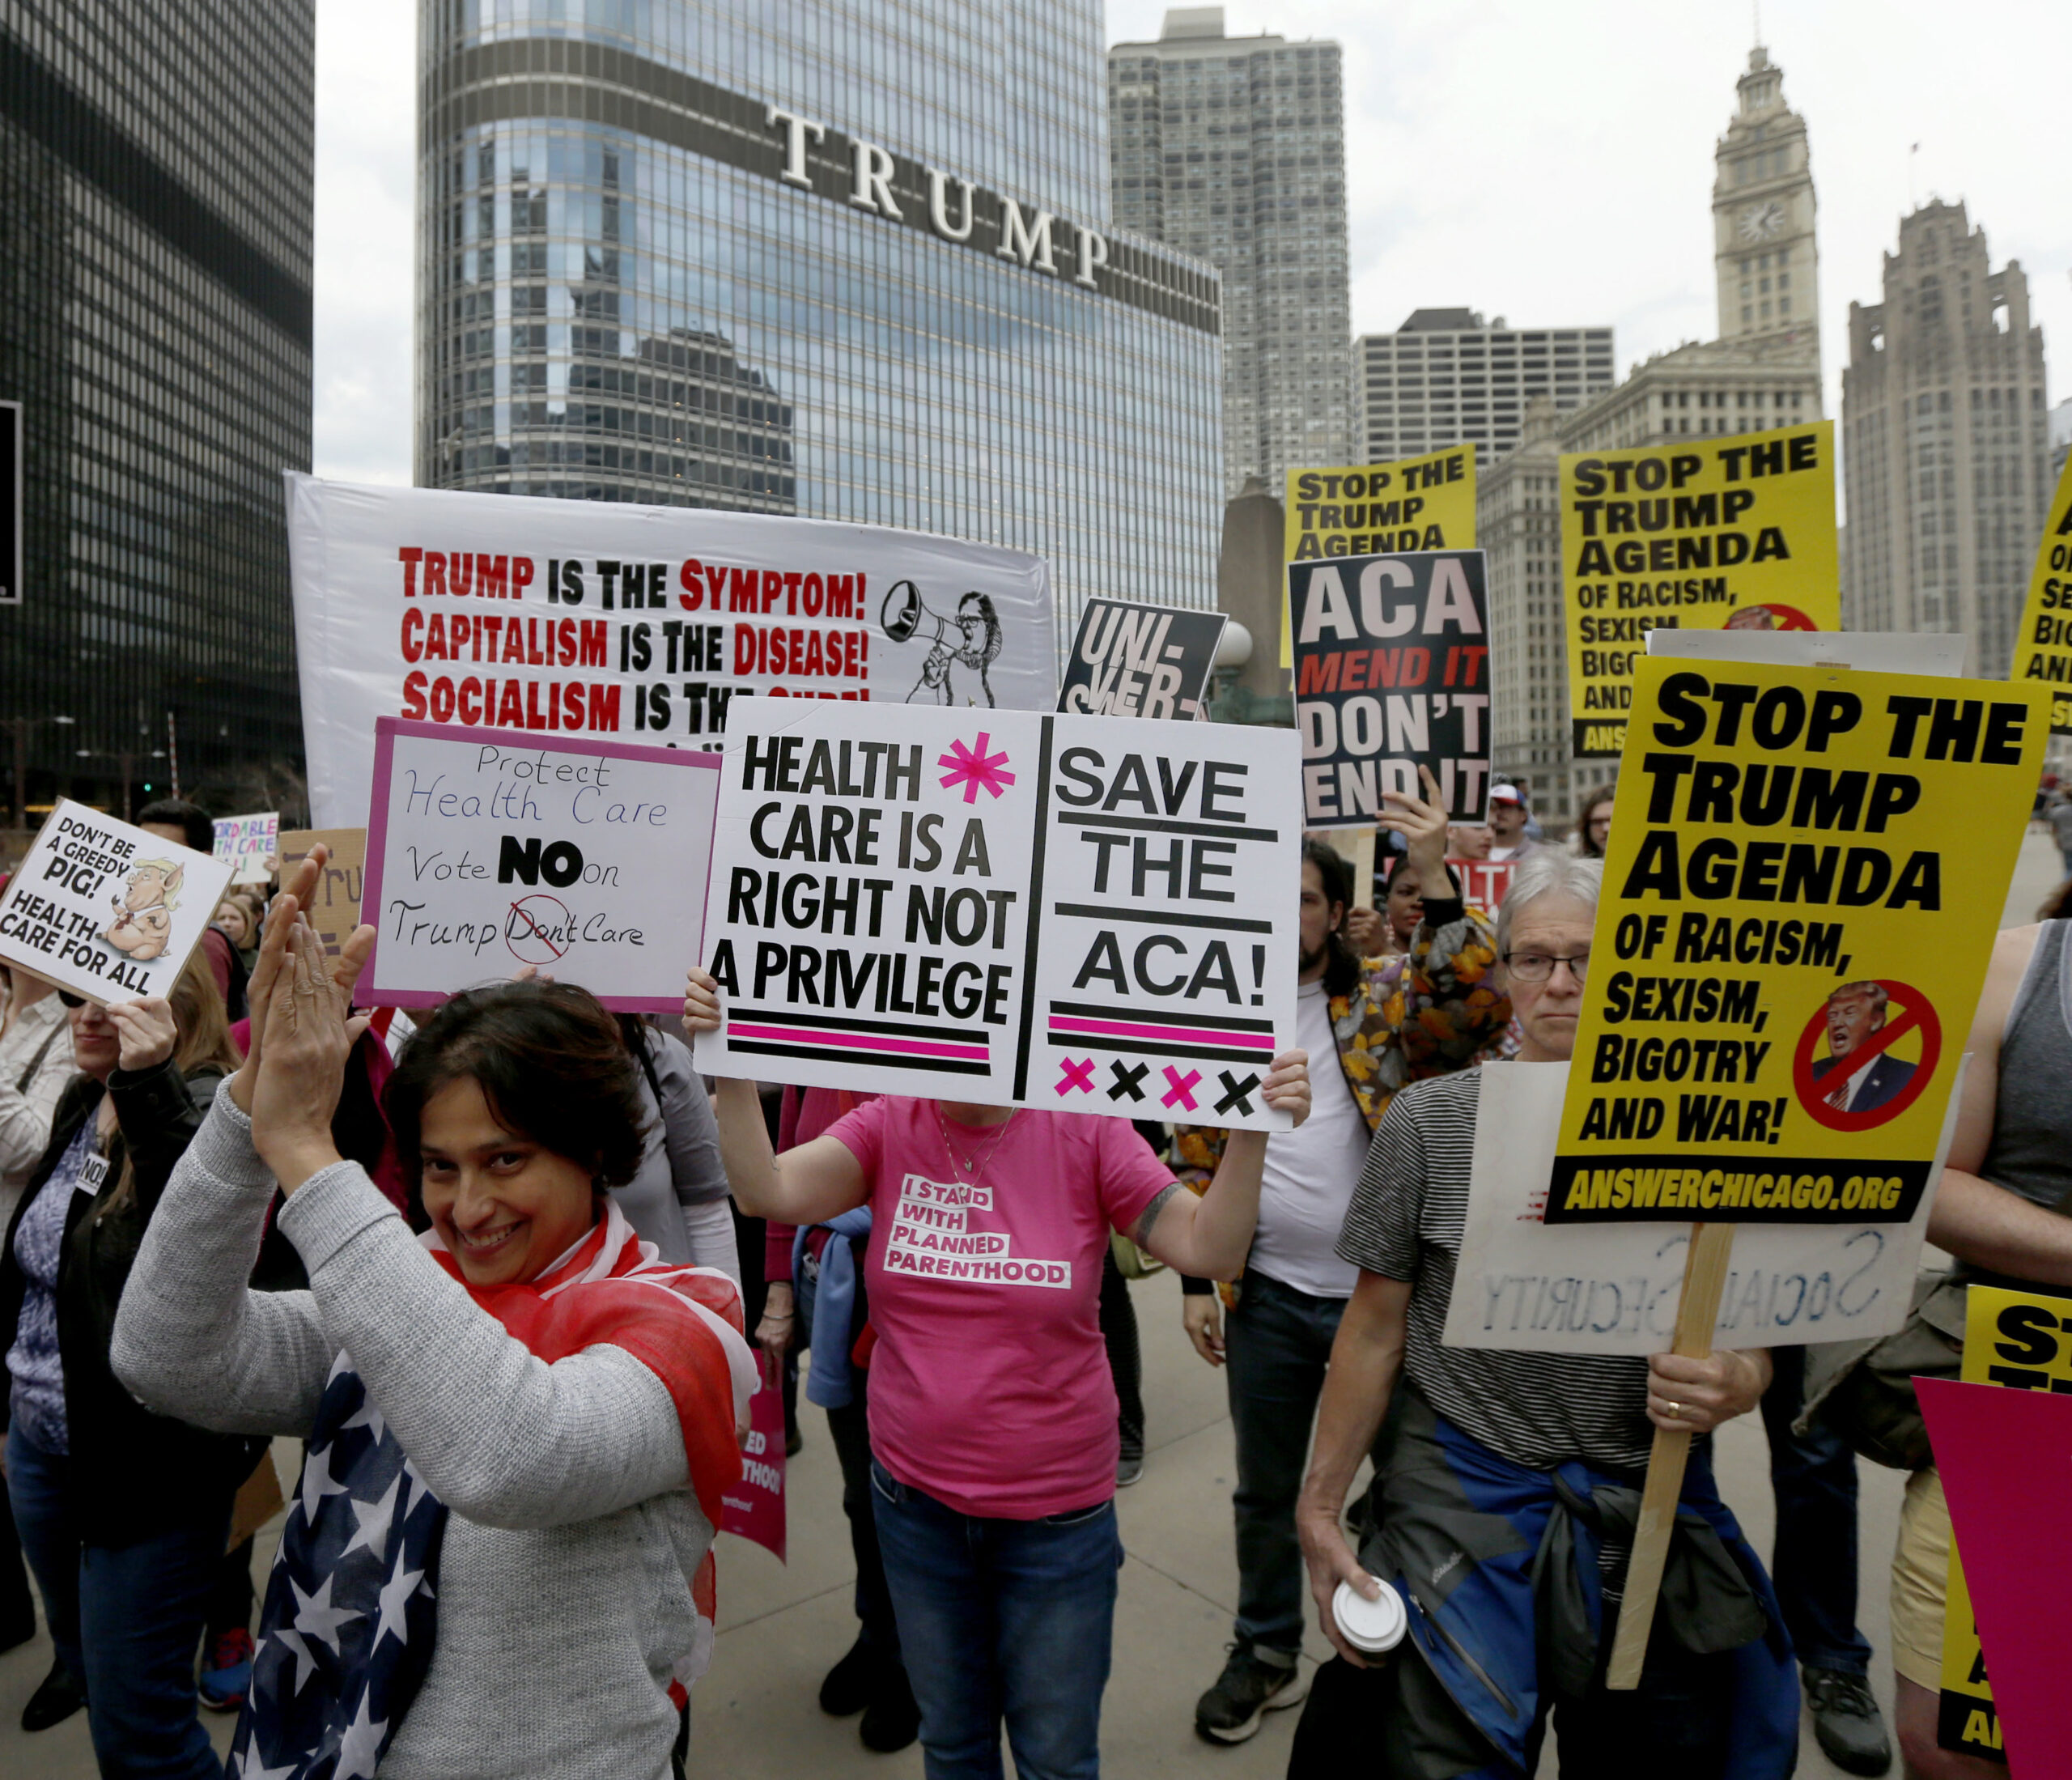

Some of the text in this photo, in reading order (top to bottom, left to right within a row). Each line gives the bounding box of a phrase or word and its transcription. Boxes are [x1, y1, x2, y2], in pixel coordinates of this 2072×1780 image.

[766, 105, 1110, 291] TRUMP
[1297, 453, 1465, 501] STOP THE
[1574, 434, 1817, 496] STOP THE
[1297, 496, 1424, 530] TRUMP
[1574, 489, 1755, 536] TRUMP
[1294, 524, 1446, 561] AGENDA
[1576, 526, 1791, 576] AGENDA
[399, 546, 866, 620] TRUMP IS THE SYMPTOM!
[1298, 558, 1483, 644] ACA
[1578, 576, 1738, 610] OF RACISM,
[401, 607, 869, 680] CAPITALISM IS THE DISEASE!
[1081, 605, 1184, 674] UNI-
[1297, 645, 1489, 695] MEND IT
[400, 669, 622, 732] SOCIALISM
[635, 682, 671, 731] IS
[1297, 694, 1489, 760] DON'T
[1653, 672, 2027, 766] STOP THE
[478, 746, 610, 787] Protect
[741, 735, 923, 802] HEALTH
[1055, 746, 1249, 823] SAVE
[1302, 758, 1489, 819] END IT
[1642, 753, 1921, 834] TRUMP
[404, 770, 667, 826] Health Care
[46, 835, 130, 878] A GREEDY
[57, 817, 136, 860] DON'T BE
[238, 837, 274, 854] CARE
[407, 835, 619, 888] Vote NO on
[749, 801, 991, 877] CARE IS A
[42, 856, 105, 899] PIG!
[1081, 831, 1237, 903] THE
[1620, 830, 1941, 912] AGENDA
[10, 890, 99, 942] HEALTH
[389, 900, 497, 956] Trump
[583, 913, 644, 946] Care
[727, 866, 1017, 949] RIGHT NOT
[0, 914, 151, 996] CARE FOR ALL
[1072, 930, 1266, 1007] ACA!
[1615, 911, 1852, 976] OF RACISM,
[710, 938, 1013, 1026] A PRIVILEGE
[1603, 971, 1768, 1034] SEXISM,
[1590, 1034, 1772, 1084] BIGOTRY
[1577, 1094, 1788, 1145] AND WAR!
[80, 1158, 106, 1186] NO!
[904, 1178, 989, 1206] I STAND
[1564, 1168, 1903, 1210] ANSWERCHICAGO.ORG
[893, 1225, 1004, 1255] PLANNED
[902, 1204, 963, 1230] WITH
[887, 1250, 1065, 1284] PARENTHOOD
